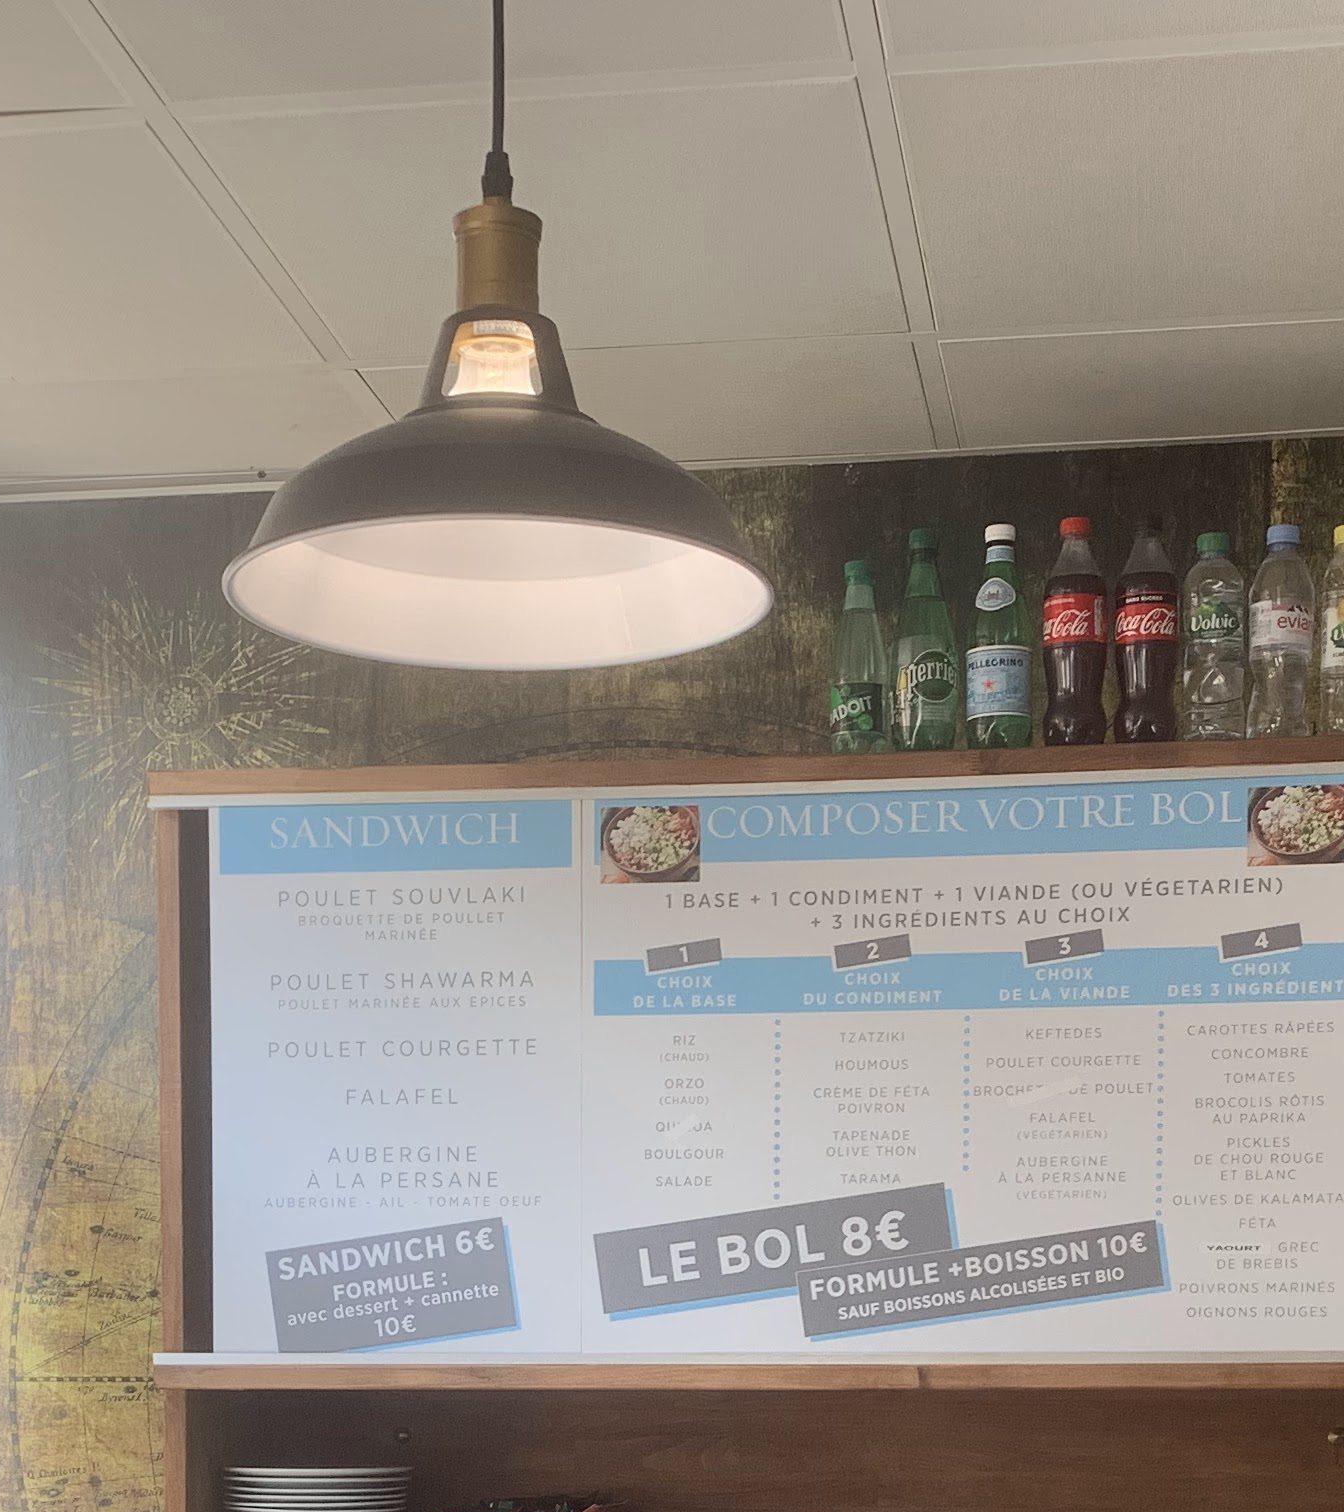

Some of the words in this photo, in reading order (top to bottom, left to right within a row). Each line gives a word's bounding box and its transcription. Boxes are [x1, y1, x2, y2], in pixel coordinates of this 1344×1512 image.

[1191, 613, 1236, 632] Volvic
[707, 800, 966, 839] COMPOSER
[976, 793, 1134, 831] VOTRE
[1151, 791, 1242, 824] BOL
[270, 812, 520, 849] SANDWICH
[278, 889, 377, 907] POULET
[392, 886, 526, 905] SOUVLAKI
[683, 892, 740, 908] BASE
[789, 888, 923, 906] CONDIMENT
[973, 883, 1061, 901] VIANDE
[1071, 881, 1113, 900] (OU
[431, 911, 505, 924] POULLET
[854, 909, 1006, 929] INGRÉDIENTS
[1017, 909, 1047, 925] AU
[1058, 906, 1130, 924] CHOIX
[365, 927, 438, 941] MARINÉE
[1254, 932, 1269, 949] 4
[1035, 967, 1094, 981] CHOIX
[1231, 962, 1292, 976] CHOIX
[270, 973, 369, 991] POULET
[385, 970, 534, 990] SHAWARMA
[657, 975, 712, 989] CHOIX
[844, 972, 901, 986] CHOIX
[999, 988, 1025, 1001] DE
[1030, 987, 1054, 1000] LA
[1060, 985, 1131, 999] VIANDE
[1167, 984, 1202, 997] DES
[278, 998, 339, 1010] POULET
[429, 996, 461, 1008] AUX
[633, 995, 656, 1008] DE
[662, 995, 685, 1008] LA
[691, 994, 737, 1007] BASE
[803, 993, 827, 1006] DU
[834, 990, 943, 1005] CONDIMENT
[1025, 1027, 1103, 1040] KEFTEDES
[1186, 1023, 1268, 1036] CAROTTES
[673, 1035, 697, 1046] RIZ
[840, 1031, 905, 1043] TZATZIKI
[268, 1041, 366, 1058] POULET
[382, 1039, 538, 1057] COURGETTE
[1211, 1047, 1309, 1060] CONCOMBRE
[835, 1058, 910, 1071] HOUMOUS
[986, 1056, 1044, 1068] POULET
[1050, 1054, 1142, 1068] COURGETTE
[664, 1078, 705, 1090] ORZO
[1224, 1071, 1296, 1084] TOMATES
[869, 1087, 888, 1098] DE
[1095, 1082, 1154, 1095] POULET
[346, 1089, 459, 1105] FALAFEL
[1194, 1095, 1272, 1109] BROCOLIS
[838, 1103, 905, 1114] POIVRON
[1030, 1111, 1096, 1124] FALAFEL
[1212, 1112, 1233, 1124] AU
[1239, 1111, 1306, 1124] PAPRIKA
[832, 1130, 911, 1141] TAPENADE
[1227, 1136, 1290, 1149] PICKLES
[328, 1146, 478, 1163] AUBERGINE
[644, 1148, 724, 1160] BOULGOUR
[826, 1146, 870, 1157] OLIVE
[875, 1145, 916, 1156] THON
[1017, 1155, 1108, 1167] AUBERGINE
[1194, 1154, 1213, 1165] DE
[1220, 1153, 1263, 1165] CHOU
[1270, 1152, 1324, 1164] ROUGE
[335, 1172, 364, 1188] LA
[380, 1171, 499, 1188] PERSANE
[656, 1176, 713, 1188] SALADE
[840, 1173, 902, 1185] TARAMA
[1016, 1172, 1034, 1184] LA
[1042, 1171, 1127, 1183] PERSANNE
[1220, 1169, 1238, 1181] ET
[1244, 1169, 1297, 1181] BLANC
[1172, 1194, 1227, 1207] OLIVES
[1234, 1194, 1254, 1206] DE
[1260, 1192, 1344, 1205] KALAMATA
[278, 1234, 445, 1281] SANDWICH
[455, 1227, 496, 1255] 6€
[638, 1240, 701, 1286] LE
[716, 1224, 825, 1275] BOL
[840, 1210, 909, 1256] 8€
[1277, 1241, 1319, 1253] GREC
[810, 1262, 940, 1300] FORMULE
[1097, 1231, 1148, 1258] 10€
[1216, 1258, 1236, 1270] DE
[1242, 1257, 1298, 1269] BREBIS
[333, 1272, 435, 1301] FORMULE
[838, 1302, 880, 1320] SAUF
[885, 1290, 965, 1315] BOISSONS
[1071, 1271, 1092, 1287] ET
[1095, 1266, 1125, 1284] BIO
[1179, 1282, 1260, 1295] POIVRONS
[287, 1308, 327, 1326] avec
[333, 1297, 399, 1320] dessert
[421, 1282, 499, 1308] cannette
[1186, 1306, 1257, 1319] OIGNONS
[1264, 1305, 1327, 1318] ROUGES
[374, 1315, 417, 1337] 10€
